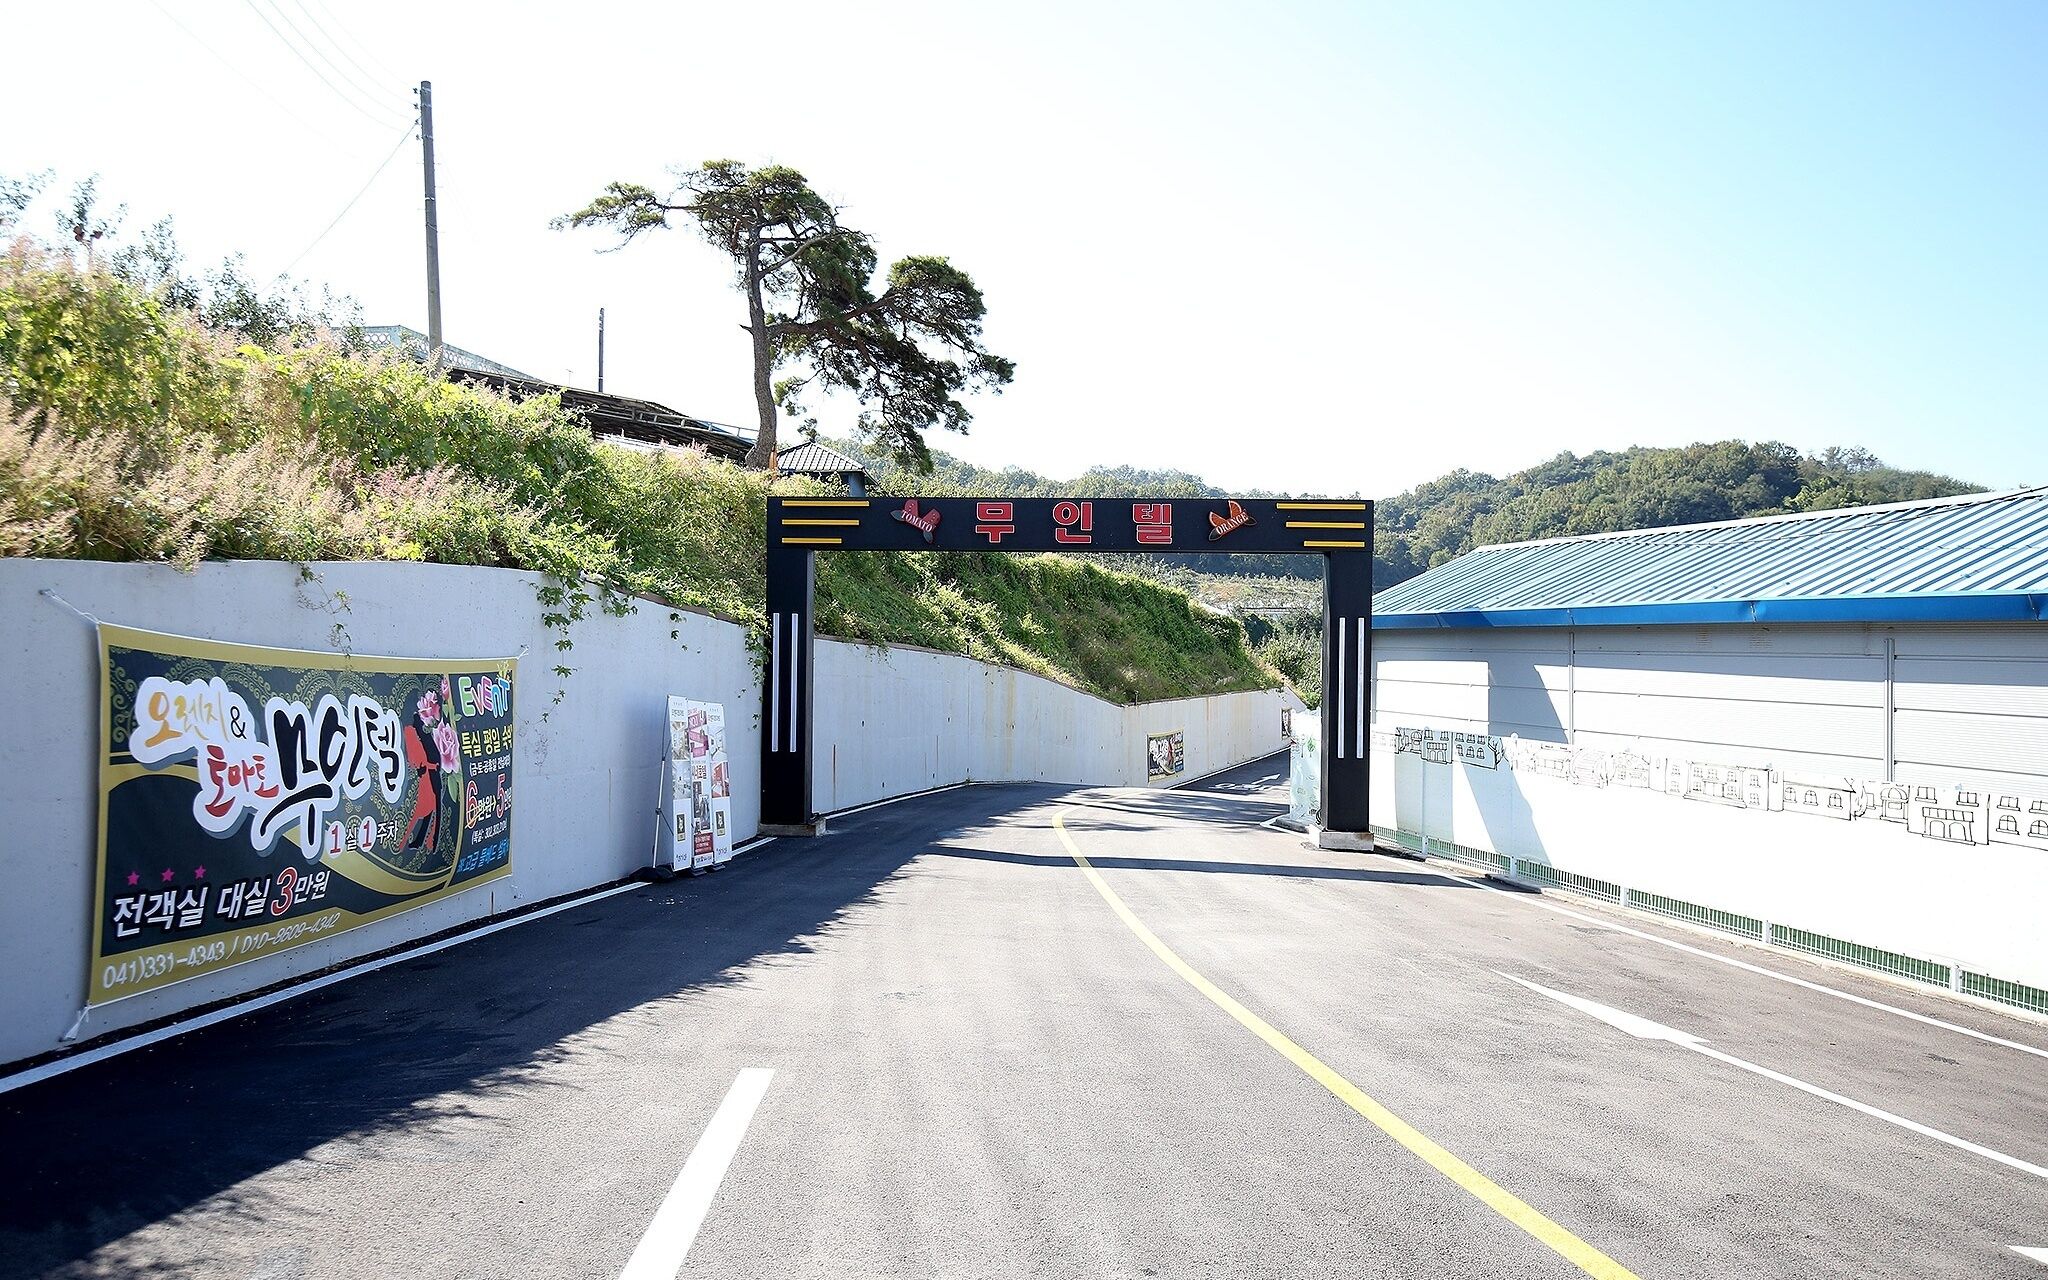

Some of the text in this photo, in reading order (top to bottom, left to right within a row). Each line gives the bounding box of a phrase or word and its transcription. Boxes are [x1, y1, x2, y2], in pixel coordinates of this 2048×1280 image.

[901, 509, 933, 533] TOMATO
[1215, 511, 1249, 535] ORANGE
[144, 690, 230, 748] 오렌지
[458, 676, 510, 718] EVENT
[461, 730, 482, 758] 특실
[483, 727, 501, 755] 평일
[204, 744, 280, 817] 토마토
[259, 704, 400, 846] 무인텔
[113, 866, 331, 938] 전객실 대실 3만원
[102, 941, 226, 989] 041)331-4343
